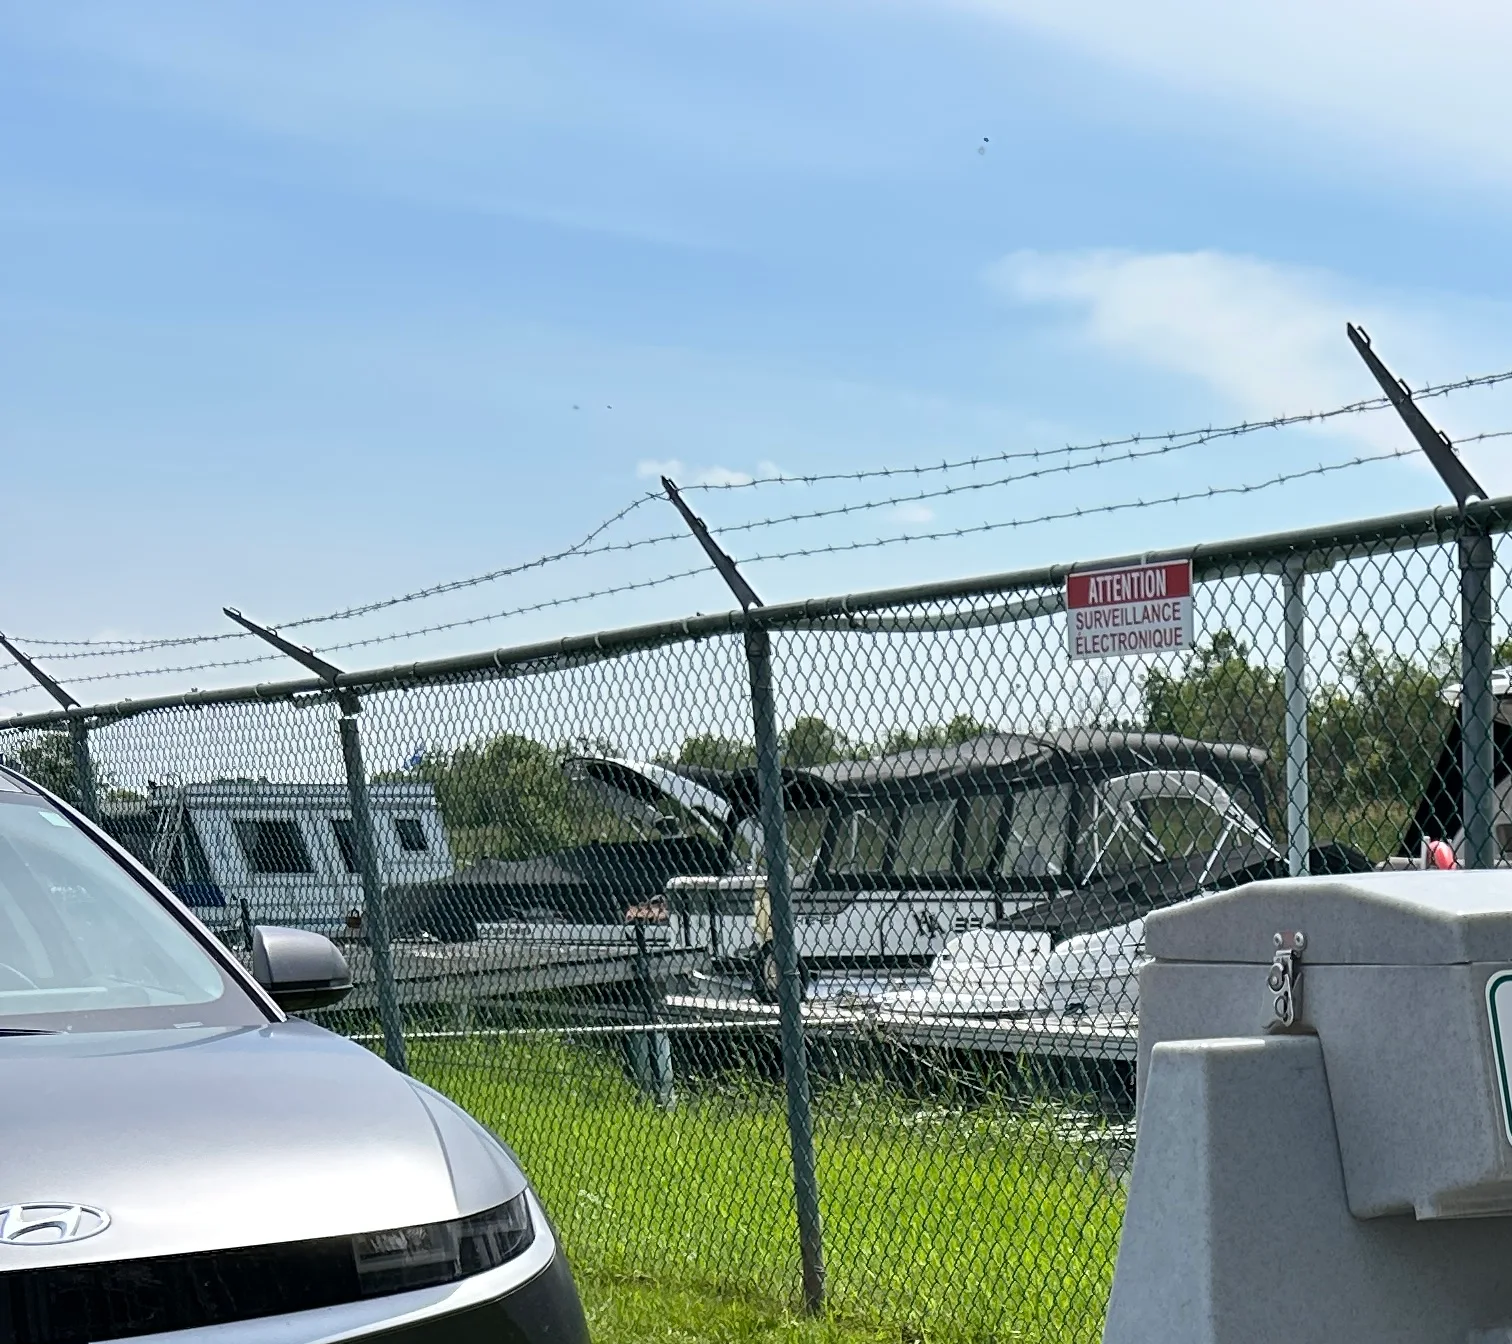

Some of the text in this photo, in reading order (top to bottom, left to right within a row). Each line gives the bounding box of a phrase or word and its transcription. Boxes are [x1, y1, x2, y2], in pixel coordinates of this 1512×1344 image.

[1088, 569, 1167, 605] ATTENTION
[1076, 602, 1182, 631] SURVEILLANCE
[1076, 627, 1183, 655] ÉLECTRONIQUE
